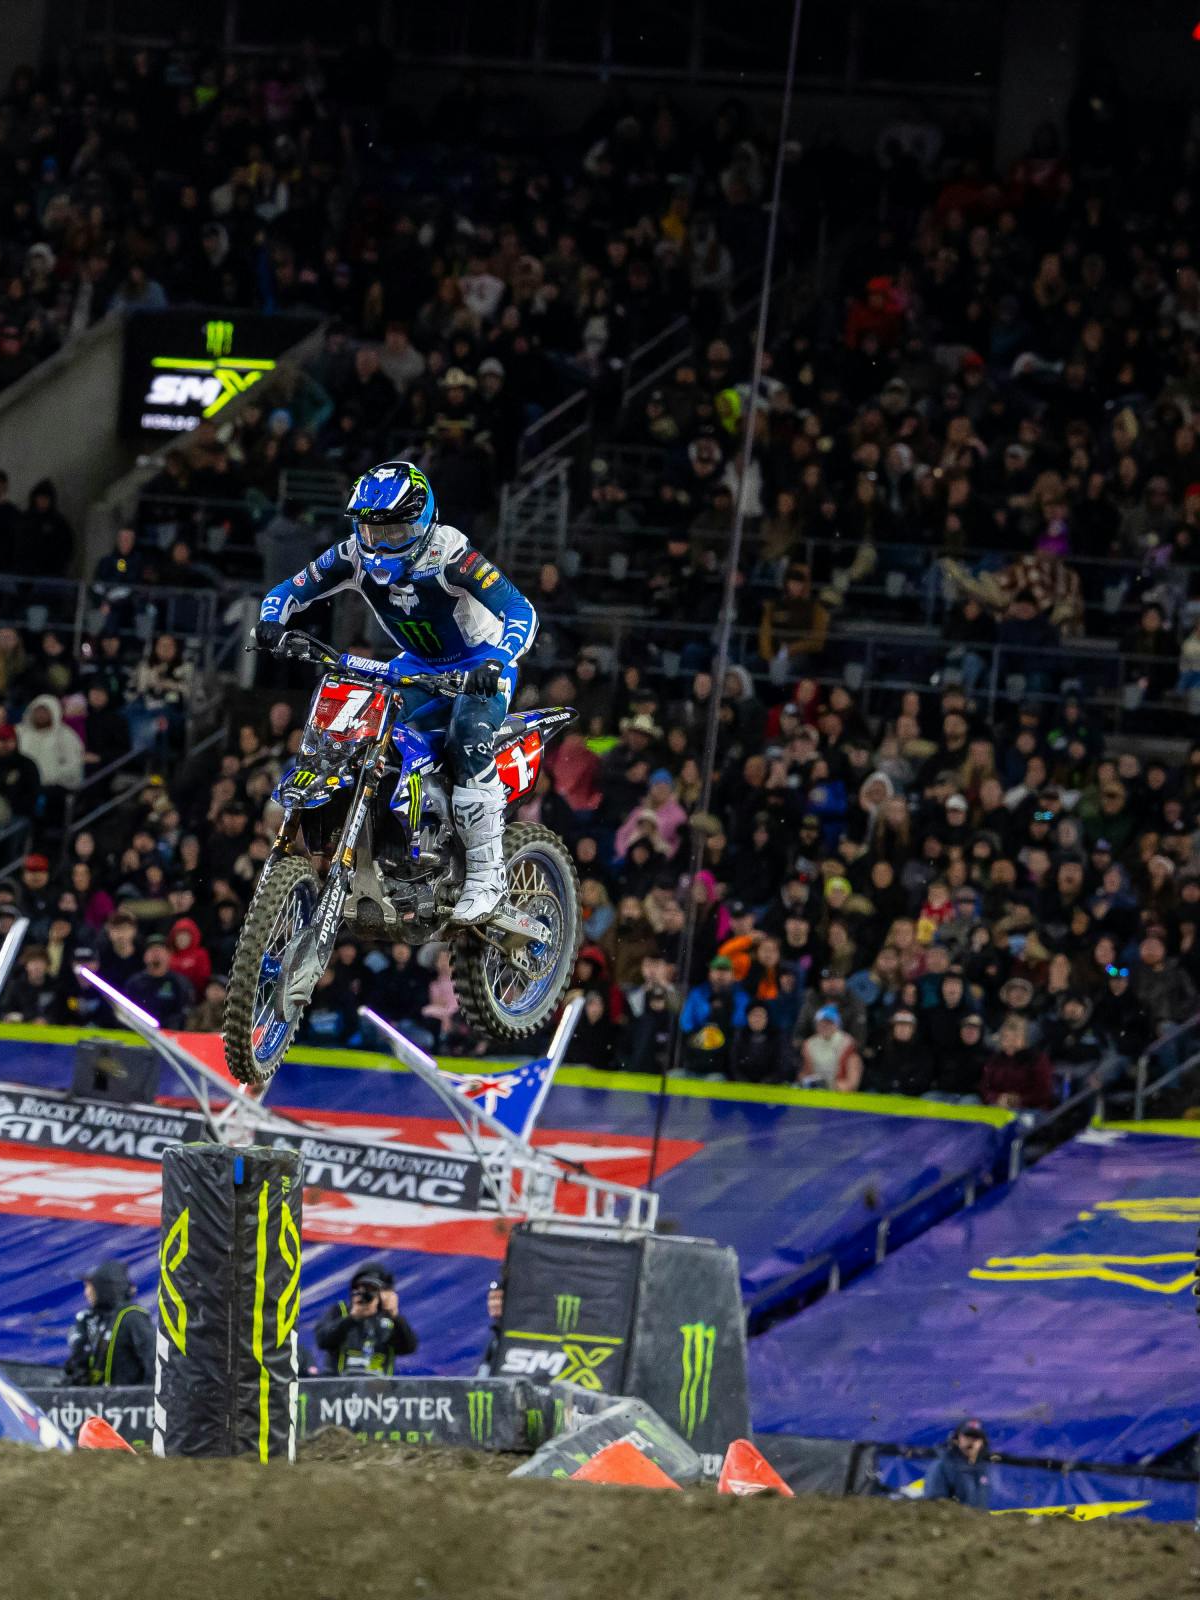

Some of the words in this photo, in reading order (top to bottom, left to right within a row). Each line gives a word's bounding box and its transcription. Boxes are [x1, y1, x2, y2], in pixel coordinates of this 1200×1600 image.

[544, 713, 571, 725] DUNLOP
[320, 878, 342, 944] DUNLOP
[18, 1097, 82, 1121] ROCKY
[81, 1105, 188, 1137] MOUNTAIN
[300, 1138, 362, 1164] ROCKY
[363, 1147, 469, 1180] MOUNTAIN
[501, 1344, 614, 1391] SMX
[320, 1391, 455, 1425] MONSTER
